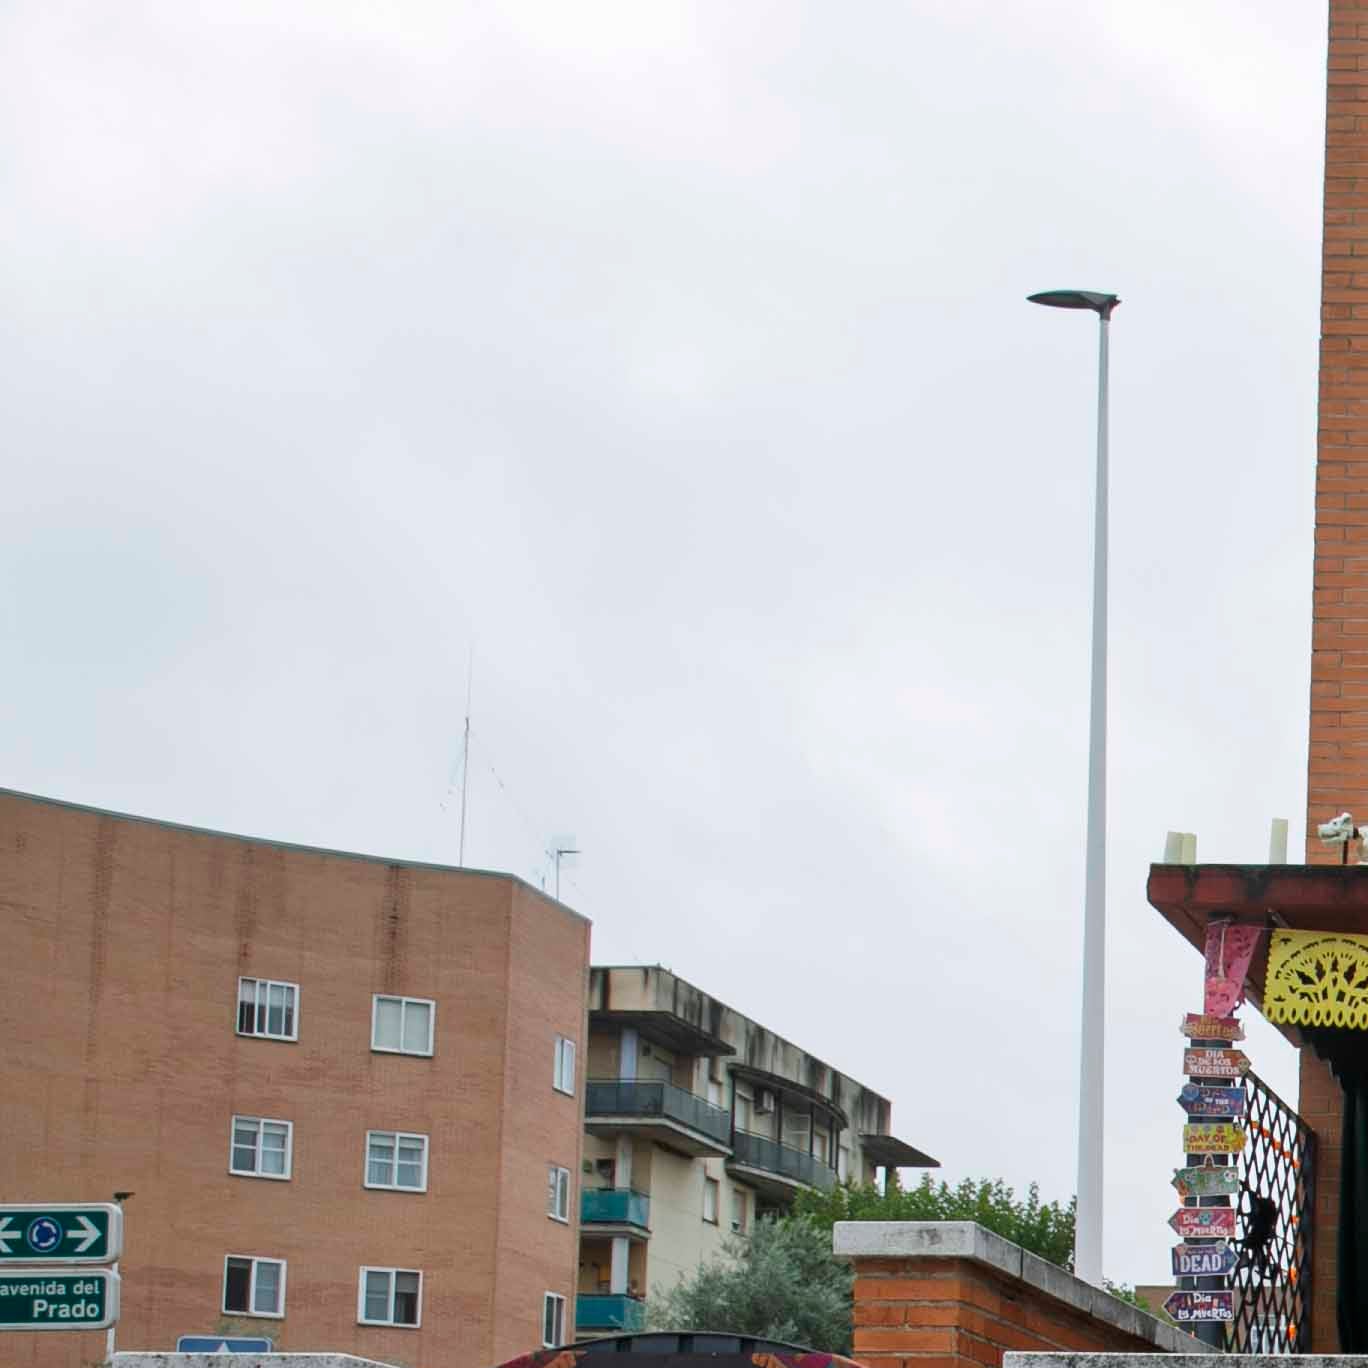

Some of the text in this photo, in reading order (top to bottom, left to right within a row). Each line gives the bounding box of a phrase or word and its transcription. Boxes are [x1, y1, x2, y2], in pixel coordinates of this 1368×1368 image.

[1180, 1254, 1222, 1272] DEAD
[0, 1280, 100, 1296] avenida del
[32, 1298, 100, 1318] Prado
